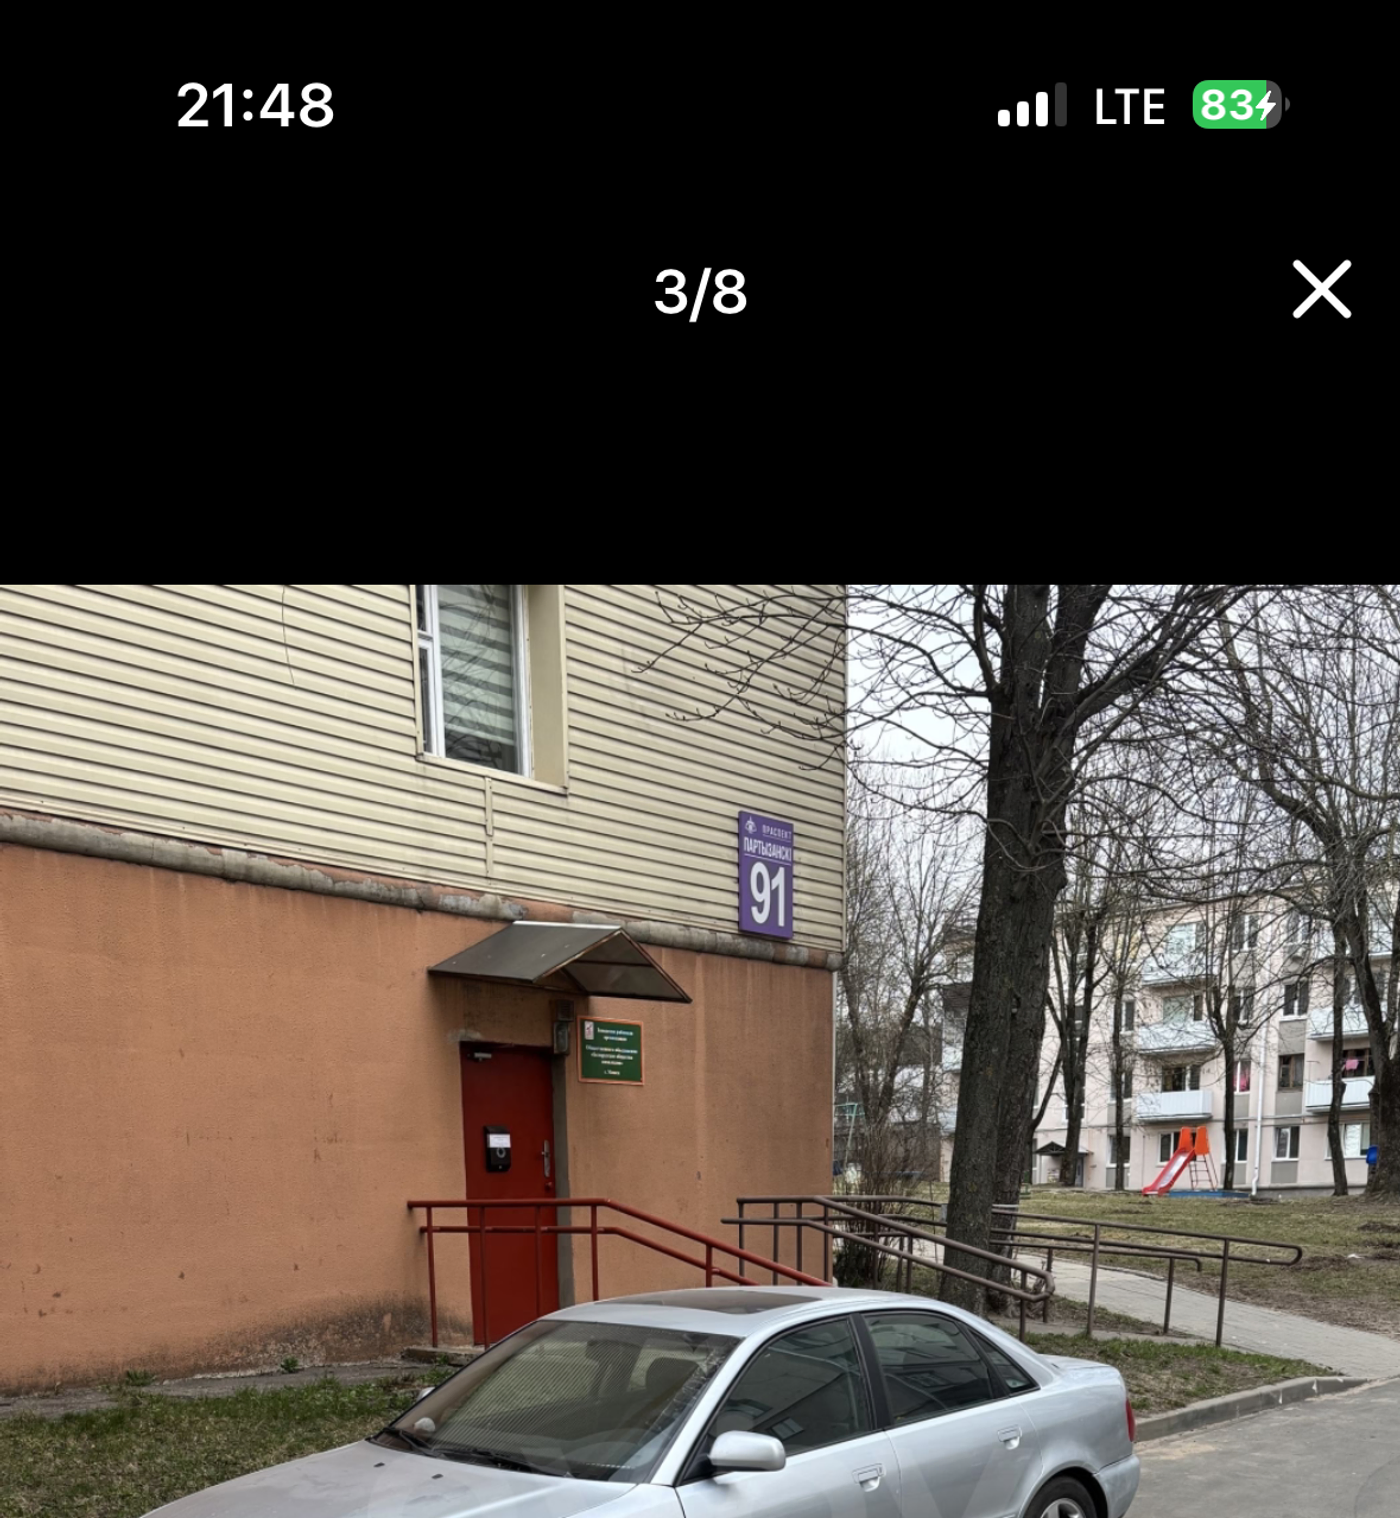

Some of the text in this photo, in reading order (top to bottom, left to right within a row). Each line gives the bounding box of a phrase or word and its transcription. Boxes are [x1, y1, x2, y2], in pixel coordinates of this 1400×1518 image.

[177, 82, 334, 128] 21:48
[1096, 88, 1165, 125] LTE
[1201, 88, 1254, 121] 83
[654, 267, 747, 323] 3/8
[743, 836, 792, 862] ПАРТЫЗАНСКІ
[762, 824, 792, 839] ПРАСПЕКТ
[750, 861, 785, 927] 91
